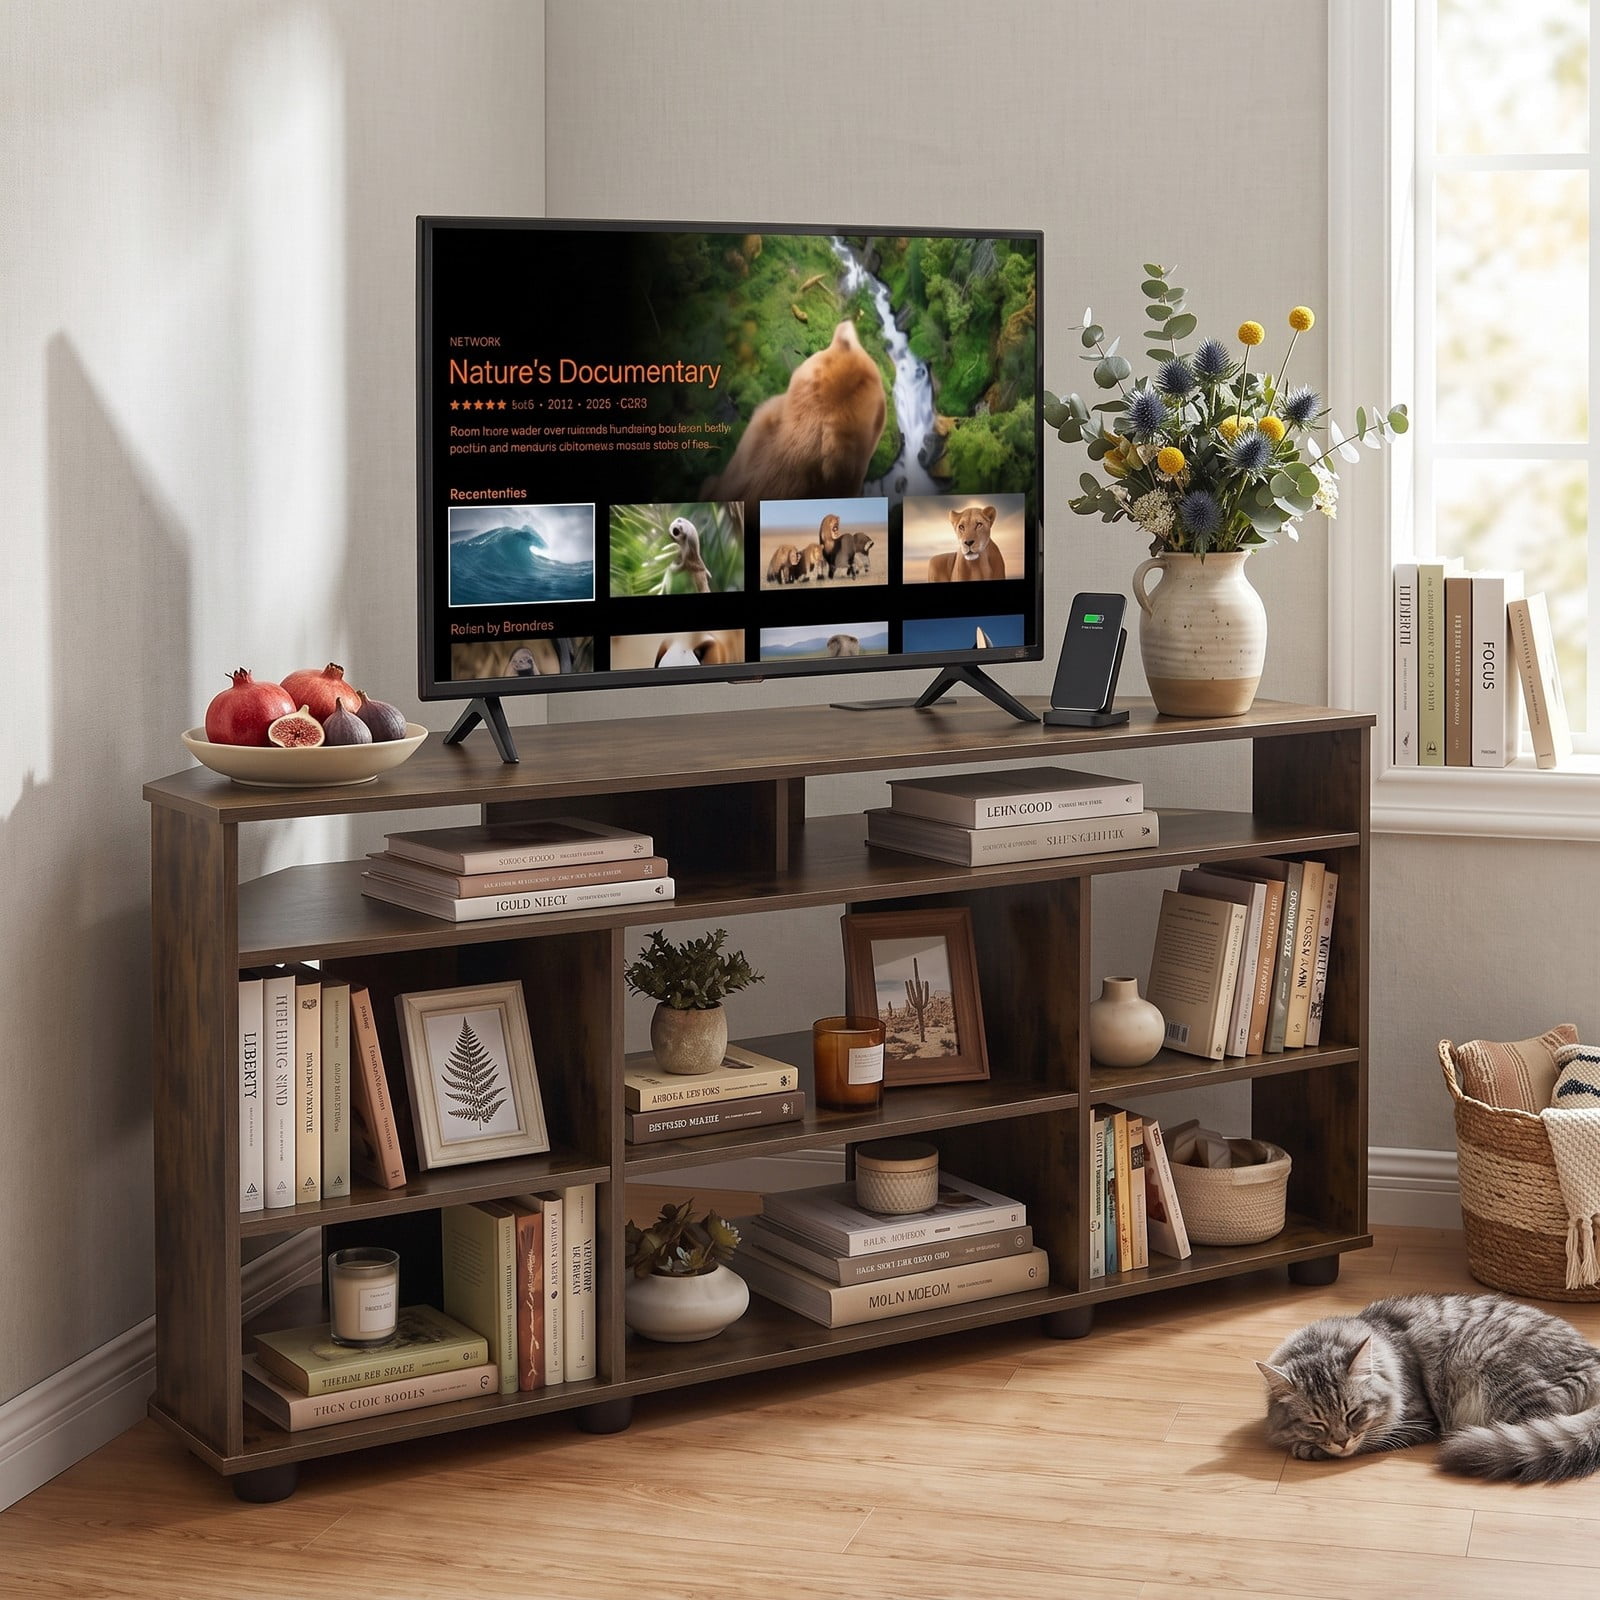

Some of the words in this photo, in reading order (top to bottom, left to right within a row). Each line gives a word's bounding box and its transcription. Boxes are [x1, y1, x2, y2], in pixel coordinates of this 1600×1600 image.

[450, 336, 501, 347] NETWORK
[450, 358, 552, 385] Nature's
[559, 358, 722, 389] Documentary
[547, 398, 574, 410] 2012
[586, 397, 612, 410] 2025
[450, 426, 480, 437] Room
[543, 426, 566, 436] over
[489, 441, 509, 453] and
[487, 621, 501, 637] by
[503, 619, 555, 633] Brondres
[1482, 641, 1495, 691] FOCUS
[987, 803, 1017, 817] LEHN
[1019, 801, 1053, 813] GOOD
[243, 1031, 258, 1100] LIBERTY
